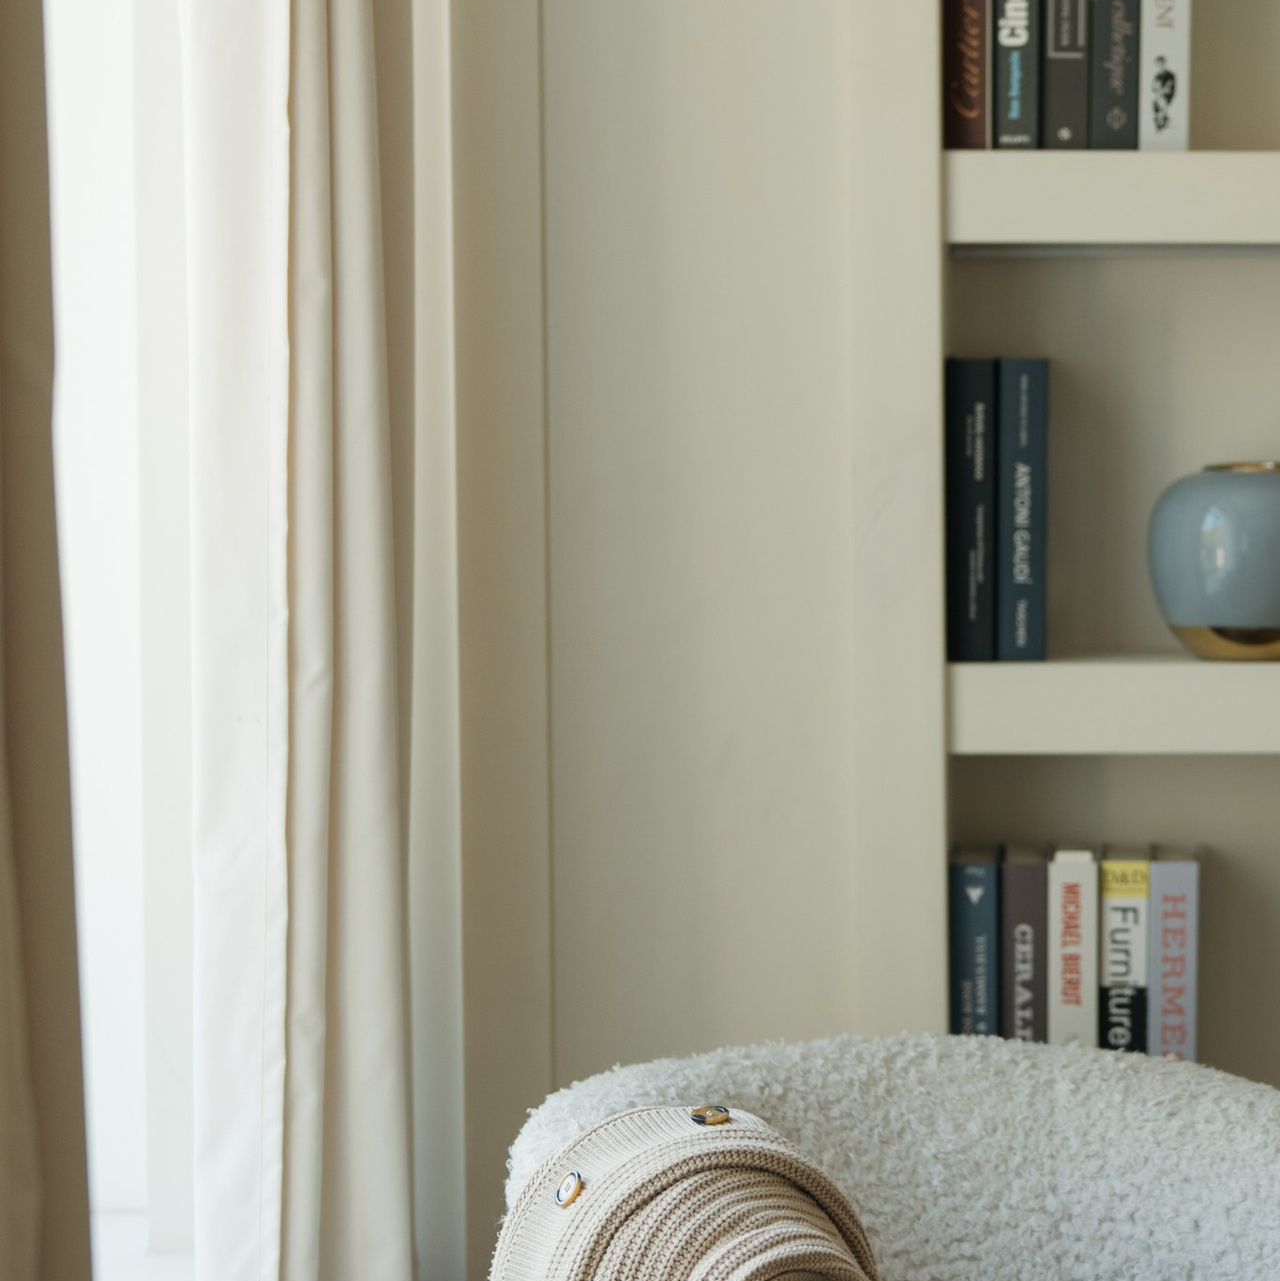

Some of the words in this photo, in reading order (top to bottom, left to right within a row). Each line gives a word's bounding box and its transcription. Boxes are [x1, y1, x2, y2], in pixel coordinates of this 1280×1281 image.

[1014, 462, 1031, 527] ANTONI
[1062, 883, 1081, 947] MICHAEL
[1062, 954, 1082, 1005] BIERUT
[1108, 907, 1138, 1046] Furniture
